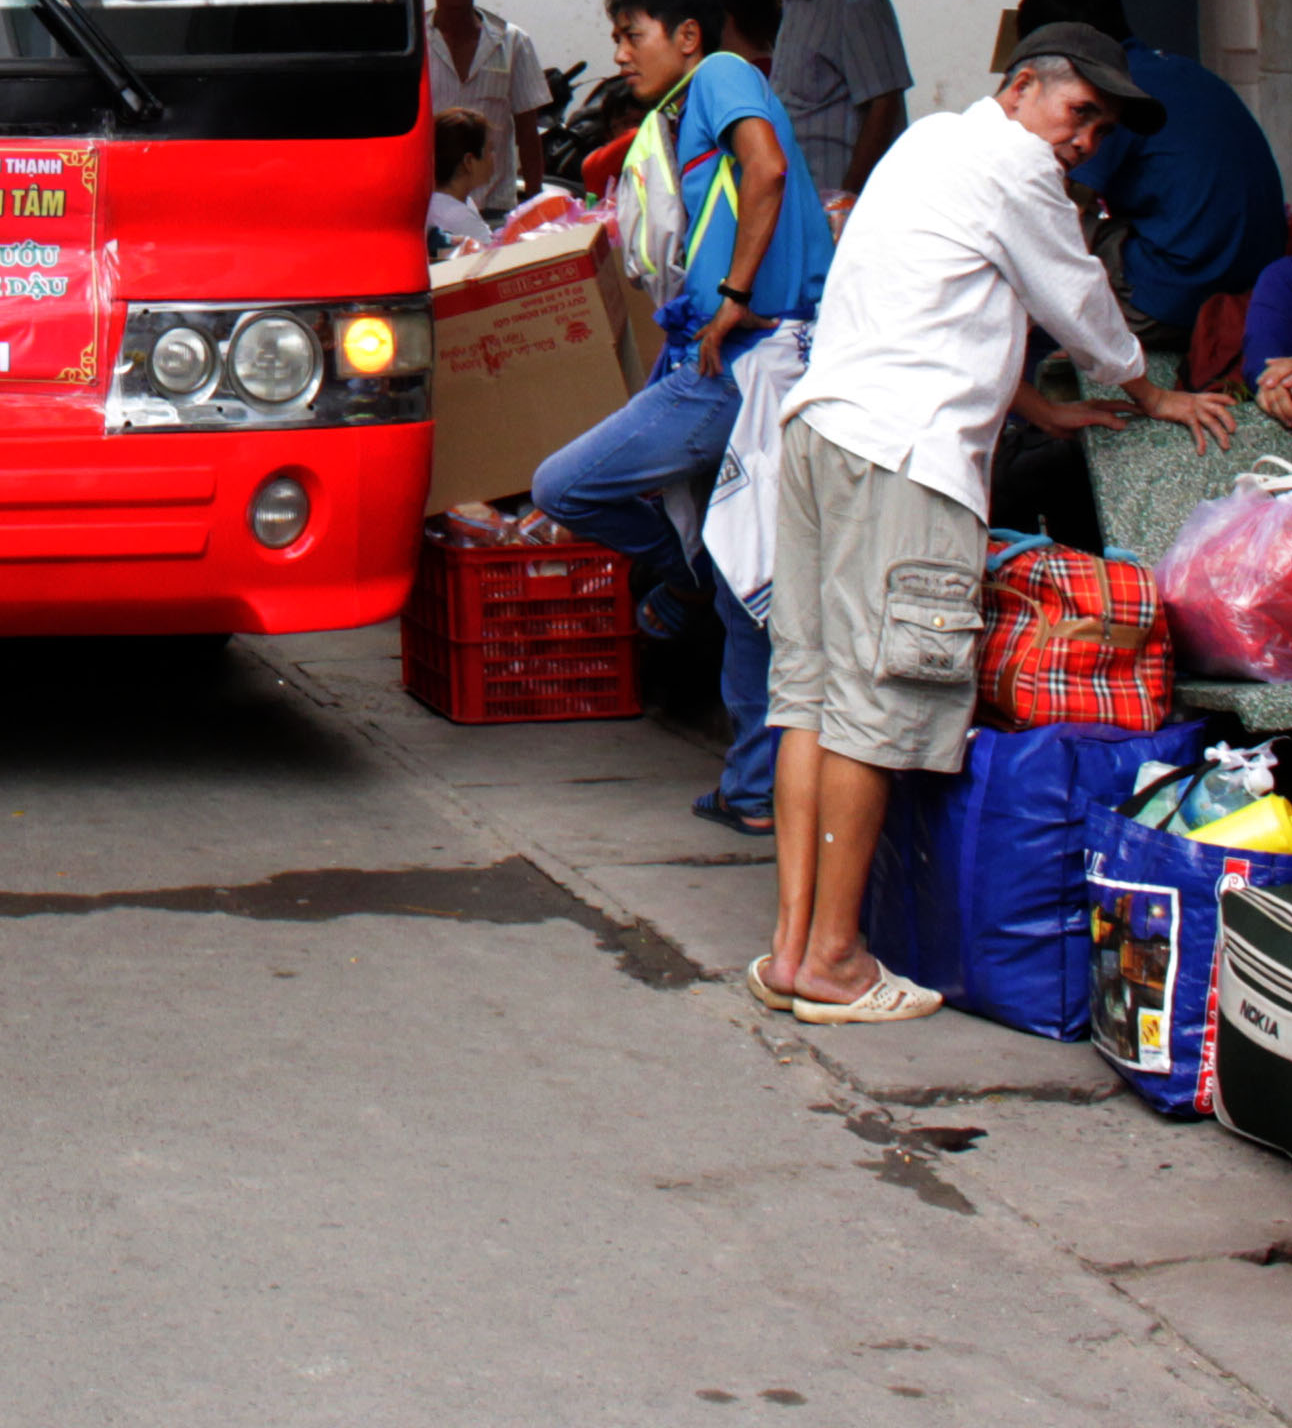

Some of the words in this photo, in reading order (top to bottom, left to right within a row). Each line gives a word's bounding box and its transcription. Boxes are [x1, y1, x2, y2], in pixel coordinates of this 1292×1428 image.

[5, 157, 63, 178] THẠNH
[11, 184, 66, 217] TÂM
[7, 272, 69, 301] DẬU
[1239, 999, 1280, 1041] NOKIA
